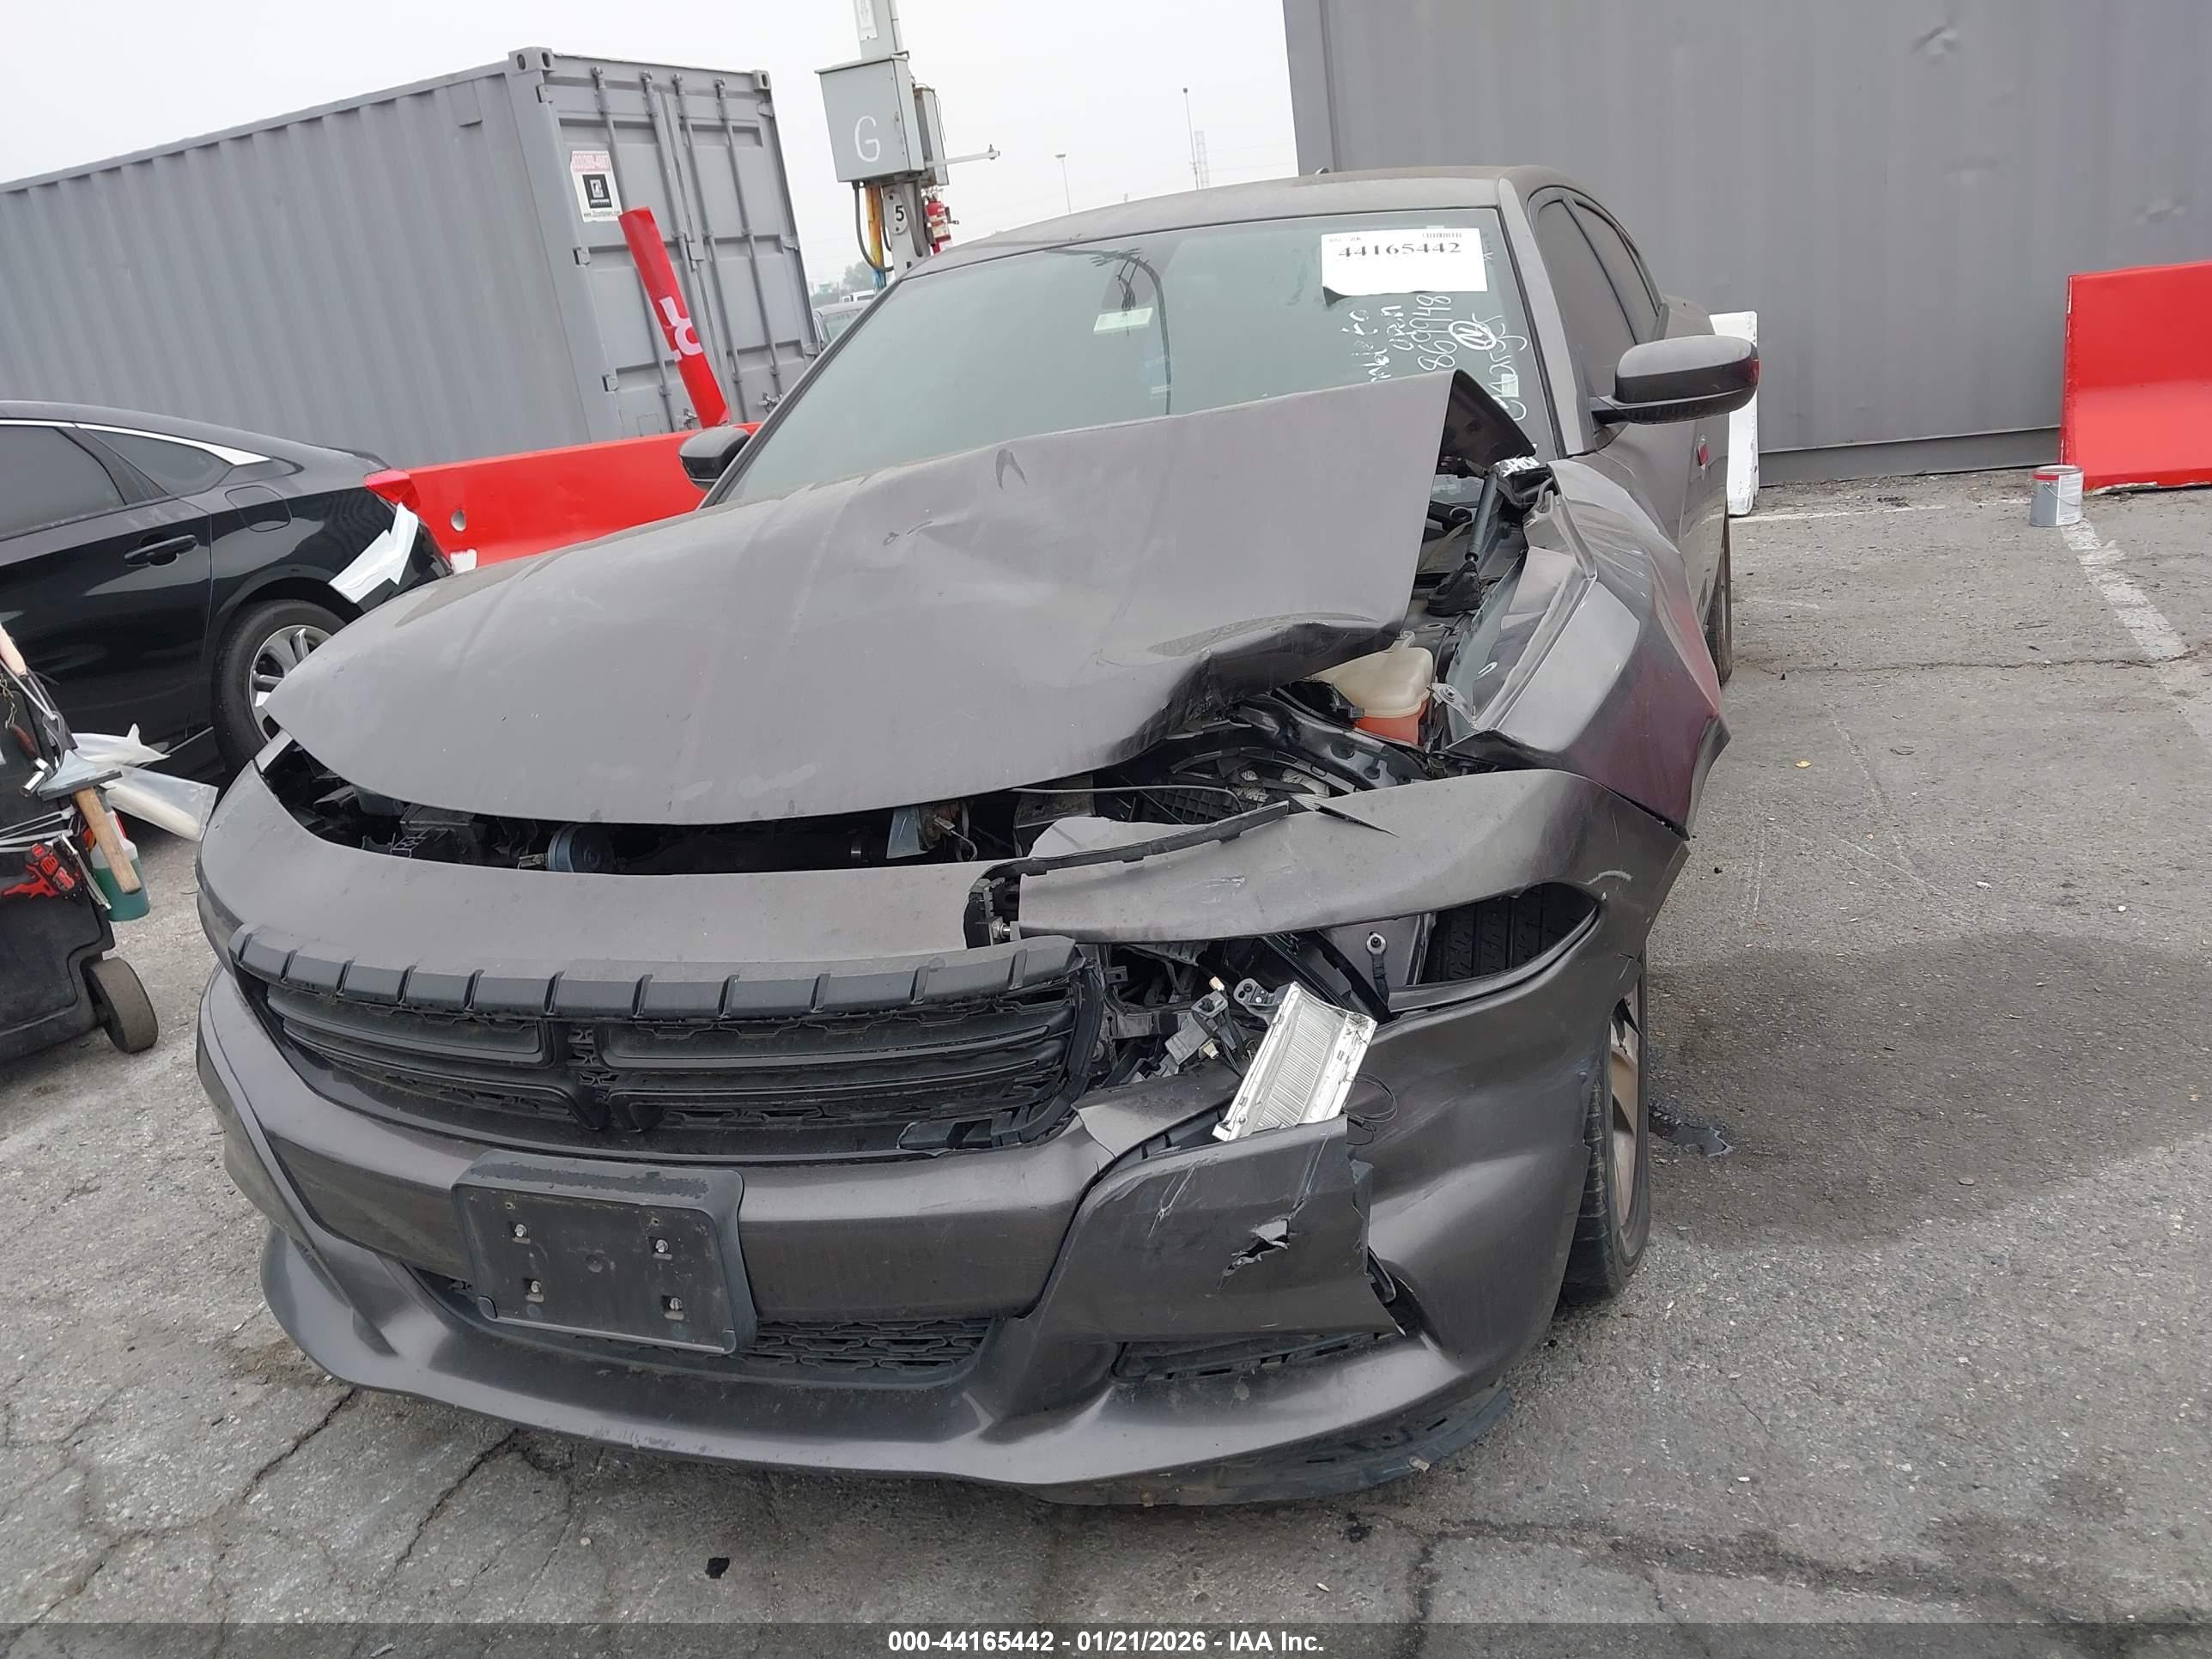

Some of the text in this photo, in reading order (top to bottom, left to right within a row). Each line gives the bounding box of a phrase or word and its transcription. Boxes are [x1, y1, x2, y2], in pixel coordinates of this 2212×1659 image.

[854, 115, 881, 162] G
[895, 204, 905, 222] 5
[1337, 242, 1462, 258] 44165442
[1408, 295, 1457, 371] 869948
